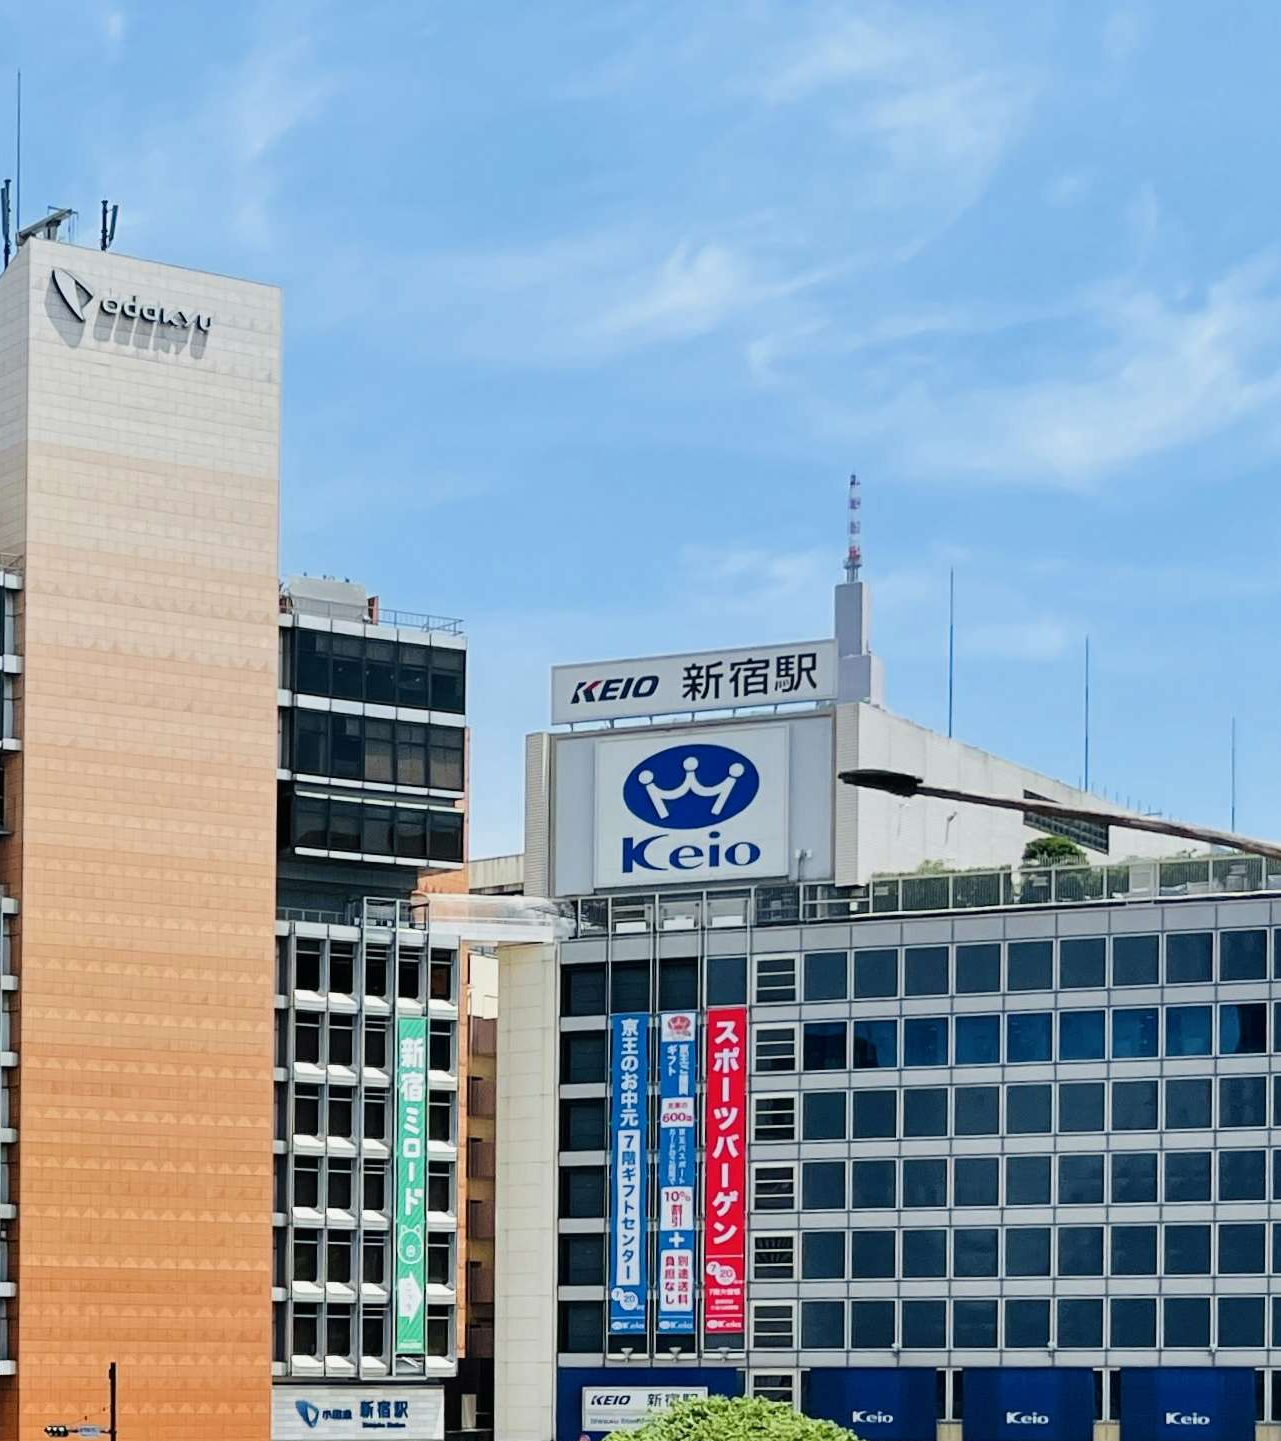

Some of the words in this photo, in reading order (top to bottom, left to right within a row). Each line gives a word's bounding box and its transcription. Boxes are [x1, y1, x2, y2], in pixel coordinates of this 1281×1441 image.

[100, 295, 212, 335] odakyu
[570, 674, 660, 705] KEIO
[682, 652, 818, 702] 新宿駅
[621, 830, 762, 874] Keio
[620, 1018, 639, 1127] 京王のお中元
[400, 1037, 424, 1216] 新宿ミロード
[713, 1020, 739, 1246] スポーツバーゲン
[621, 1134, 637, 1281] 7階ギフトセンター
[359, 1400, 409, 1419] 新宿駅
[590, 1394, 631, 1406] KEIO
[852, 1409, 894, 1424] Keio
[1005, 1410, 1049, 1425] Keio
[1165, 1411, 1210, 1426] Keio
